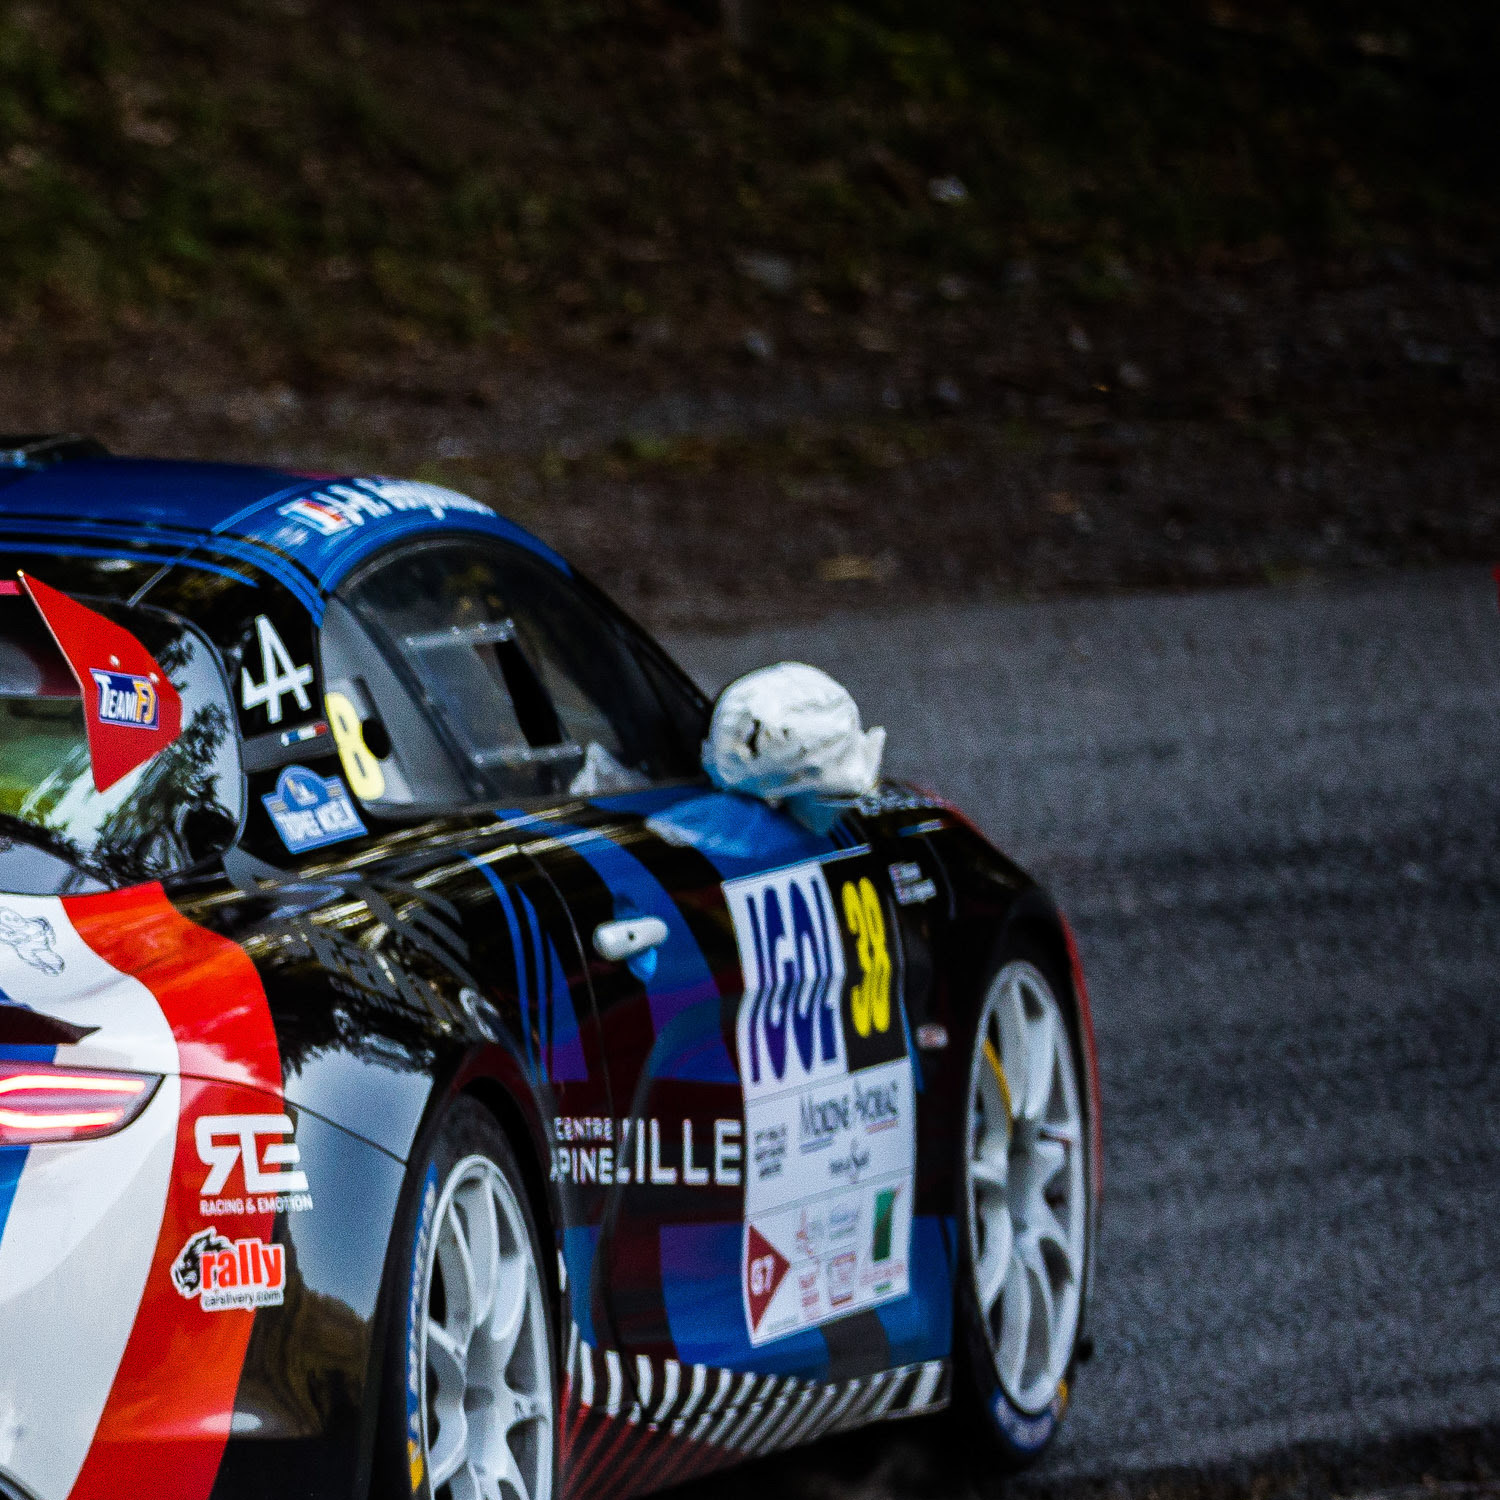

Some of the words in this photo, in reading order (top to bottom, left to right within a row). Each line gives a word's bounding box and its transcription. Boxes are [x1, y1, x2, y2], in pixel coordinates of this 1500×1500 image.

[745, 875, 837, 1084] IGOL
[841, 875, 892, 1038] 38
[553, 1116, 613, 1142] CENTRE
[200, 1197, 245, 1216] RACING
[245, 1197, 256, 1214] &
[257, 1195, 314, 1214] EMOTION
[202, 1242, 283, 1290] rally
